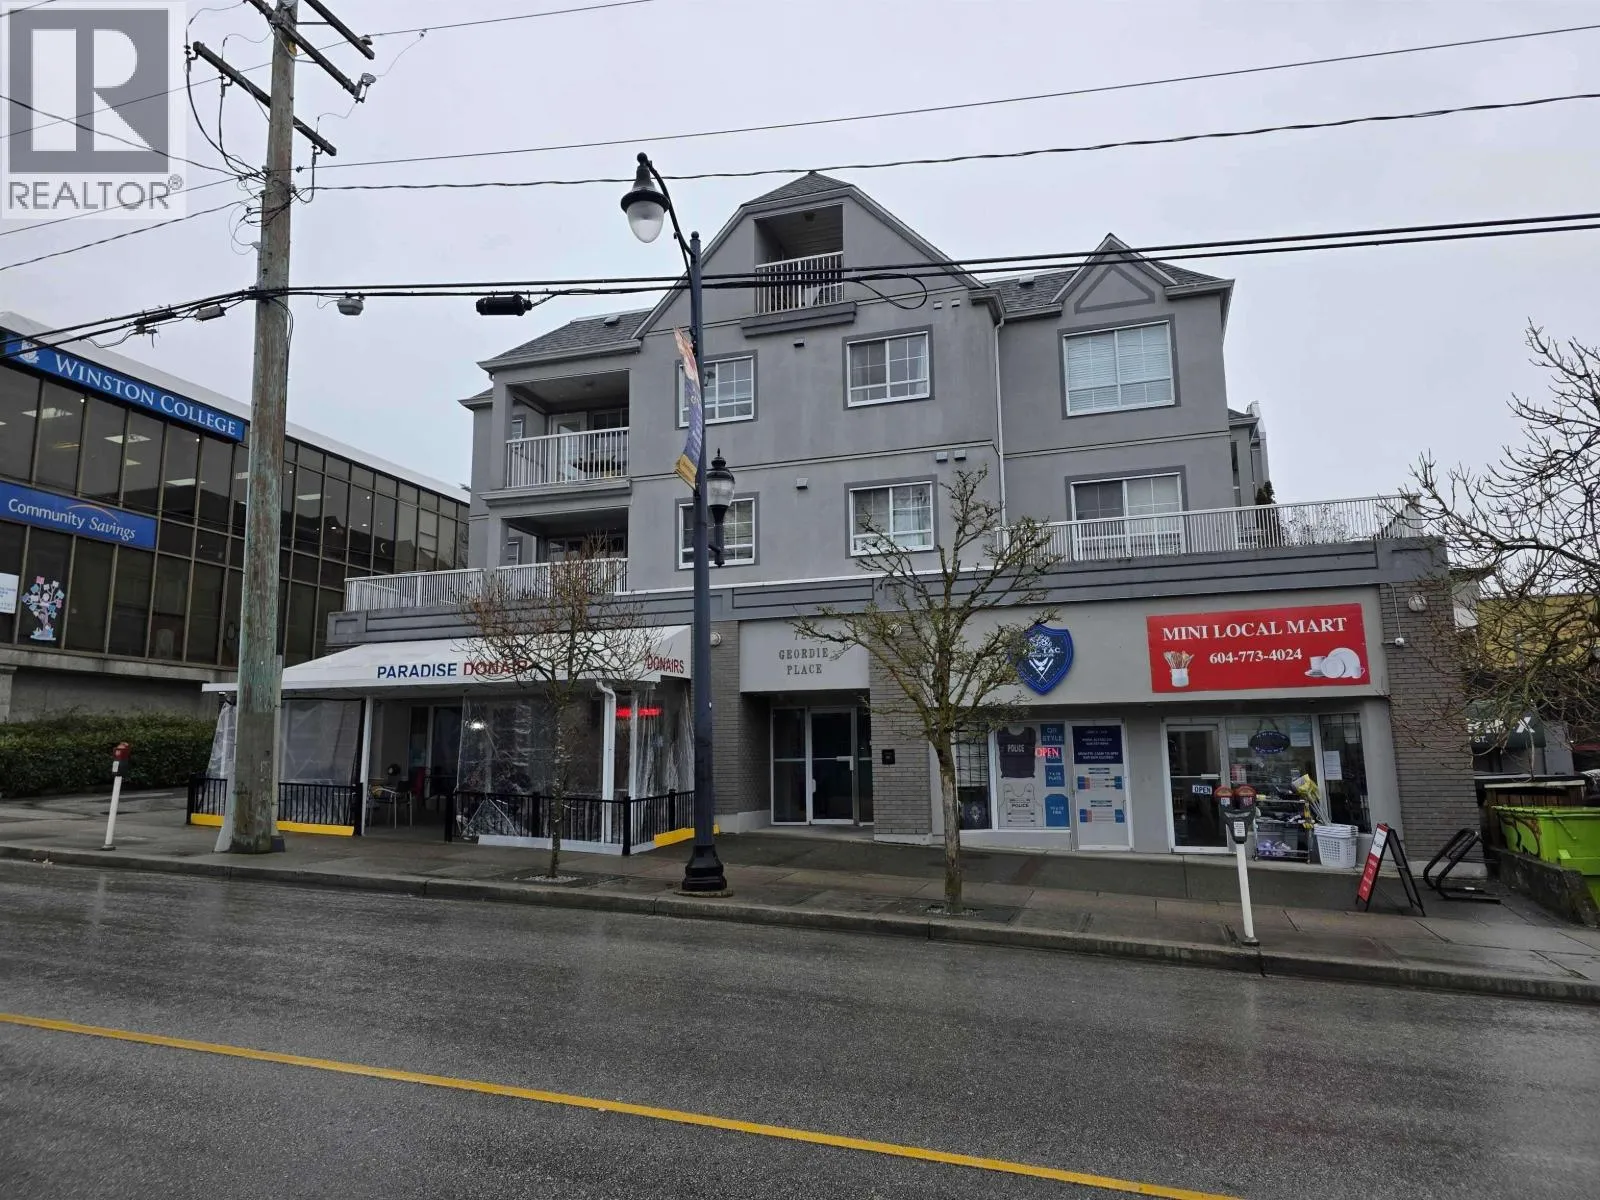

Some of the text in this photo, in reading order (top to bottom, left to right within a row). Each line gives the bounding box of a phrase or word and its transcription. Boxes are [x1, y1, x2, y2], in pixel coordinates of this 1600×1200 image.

[55, 354, 236, 436] WINSTON COLLEGE
[8, 498, 136, 541] Community Savings
[1161, 617, 1347, 641] MINI LOCAL MART
[778, 647, 829, 660] GEORDIE
[1209, 648, 1303, 664] 604-773-4024
[377, 662, 458, 679] PARADISE
[647, 655, 685, 674] DONAIRS
[787, 663, 823, 675] PLACE
[1007, 744, 1025, 753] POLICE
[1035, 747, 1059, 758] OPEN
[1194, 786, 1211, 794] OPEN
